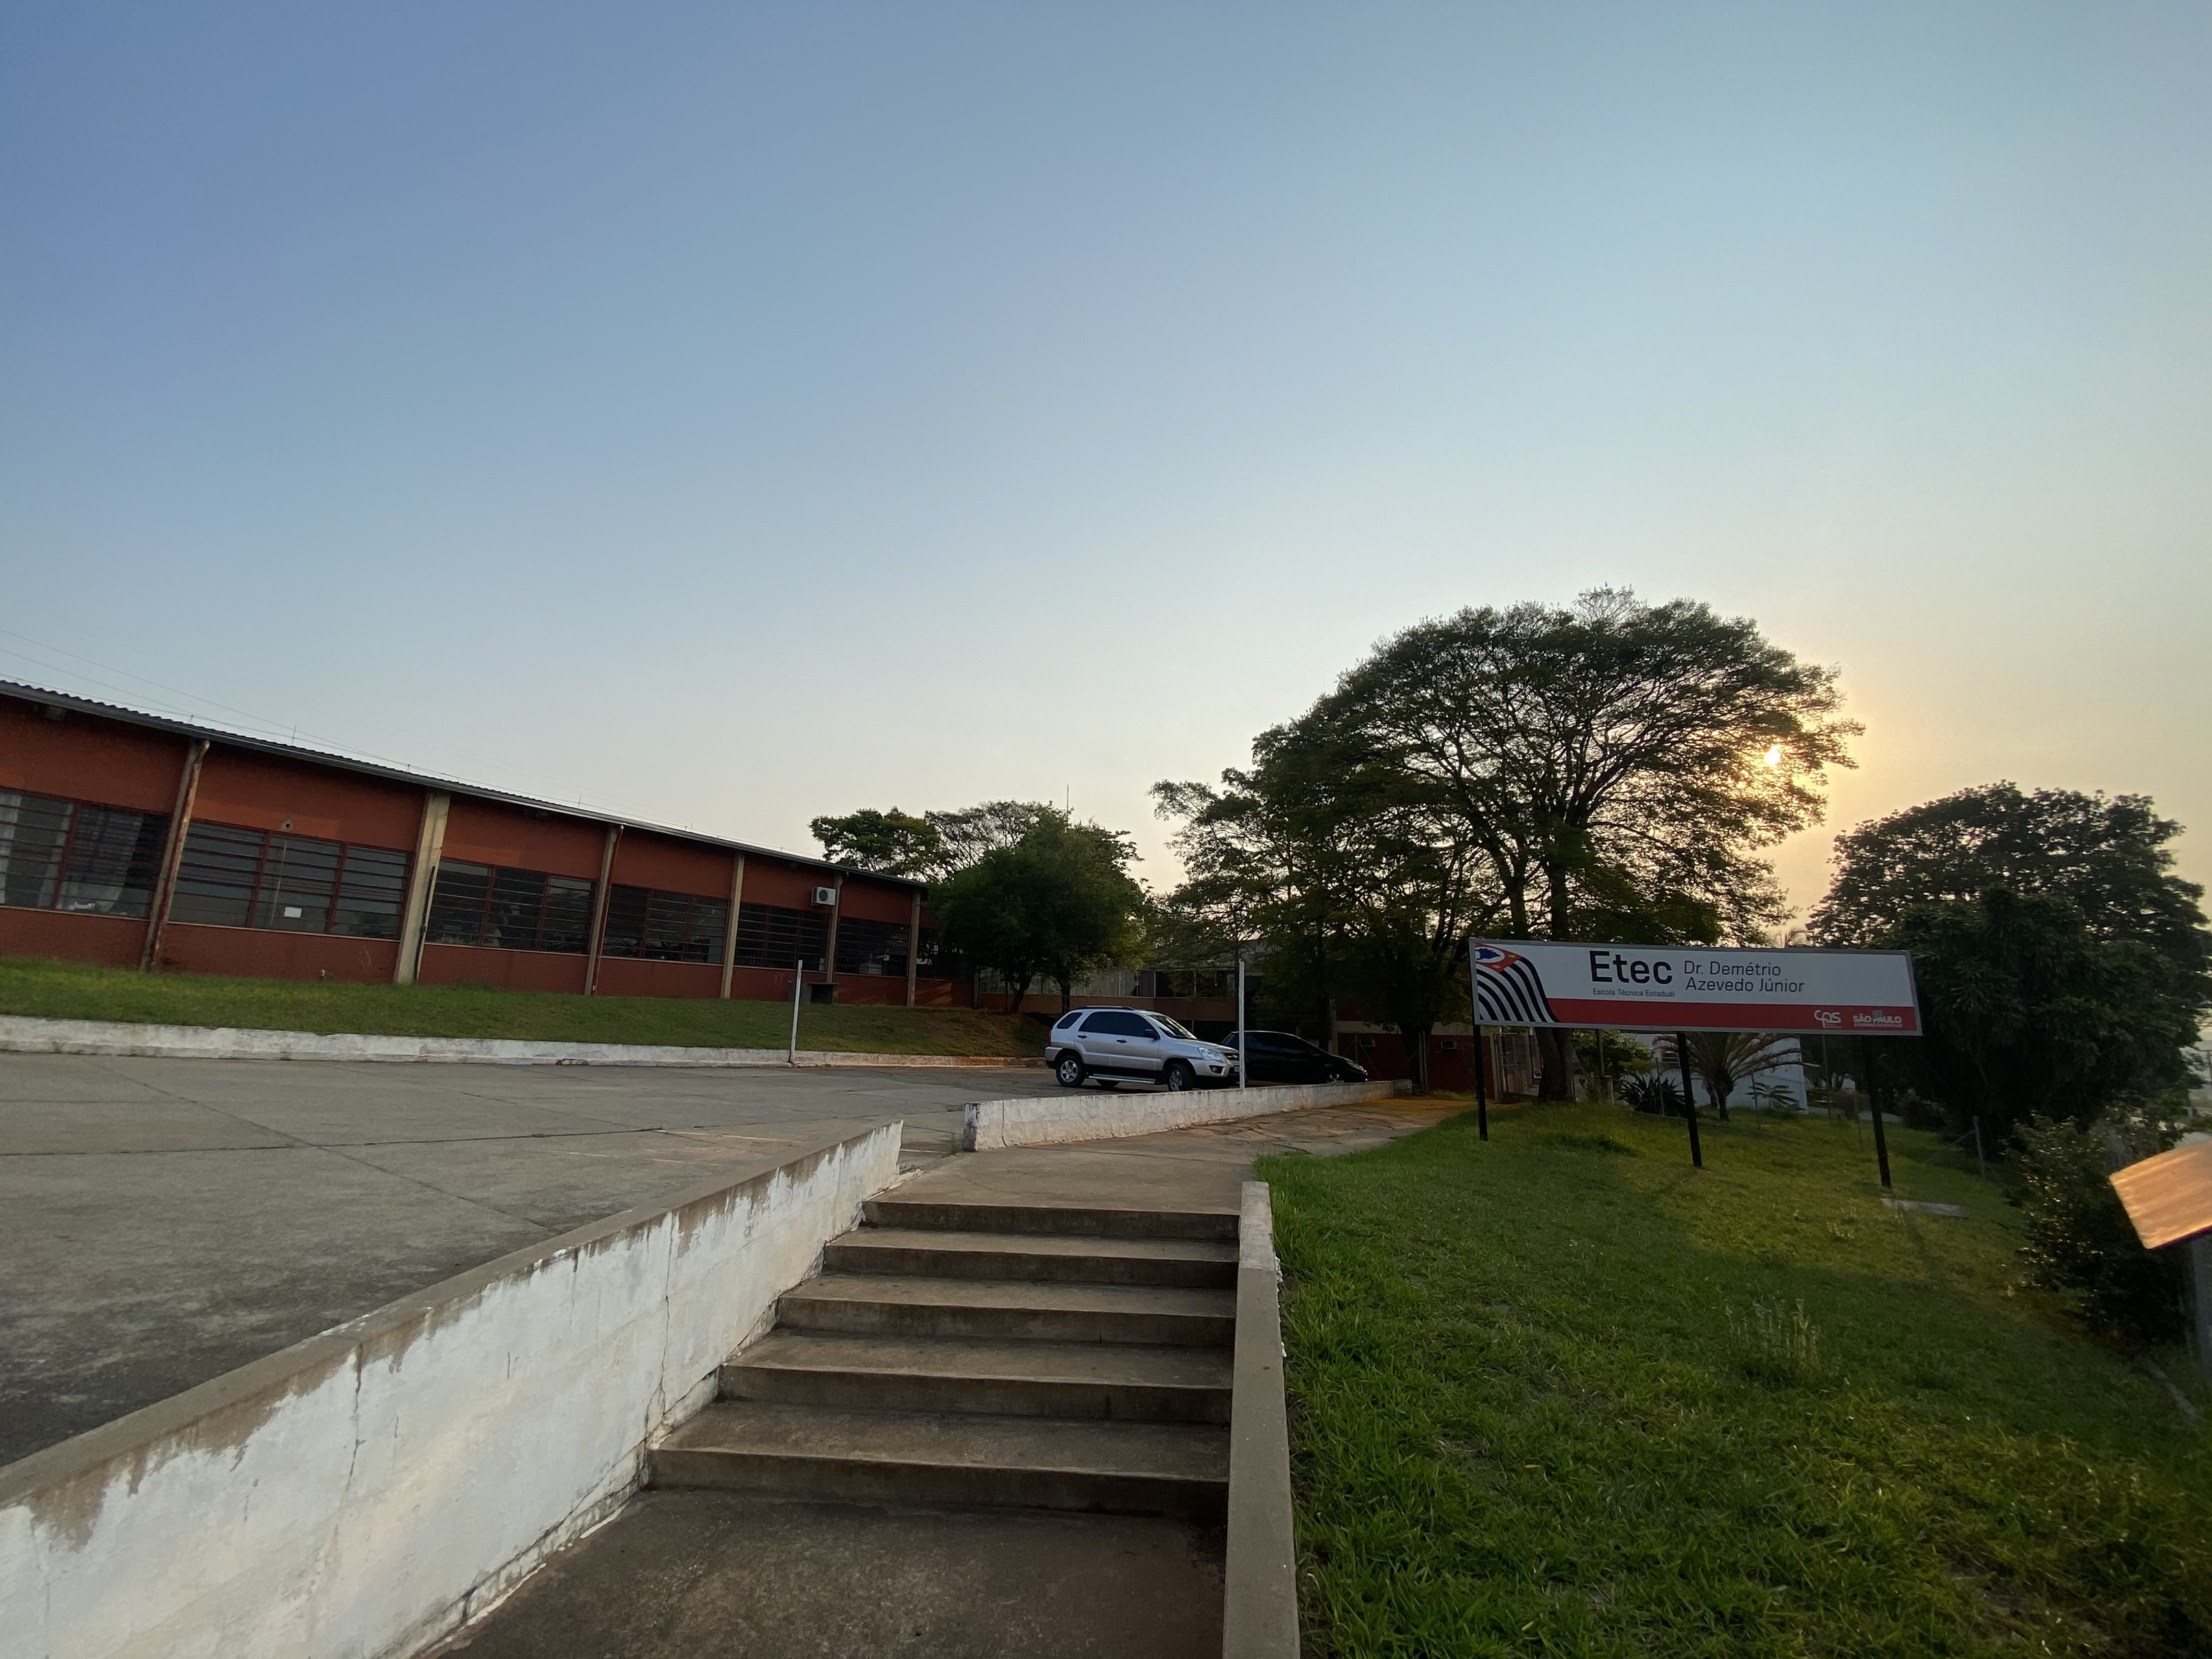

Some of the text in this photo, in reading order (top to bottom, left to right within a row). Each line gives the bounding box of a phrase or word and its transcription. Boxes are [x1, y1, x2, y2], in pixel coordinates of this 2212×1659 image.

[1589, 951, 1672, 984] Etec
[1684, 960, 1781, 976] Dr. Demétrio
[1685, 977, 1805, 992] Azevedo Júnior
[1853, 1014, 1872, 1023] SÃO
